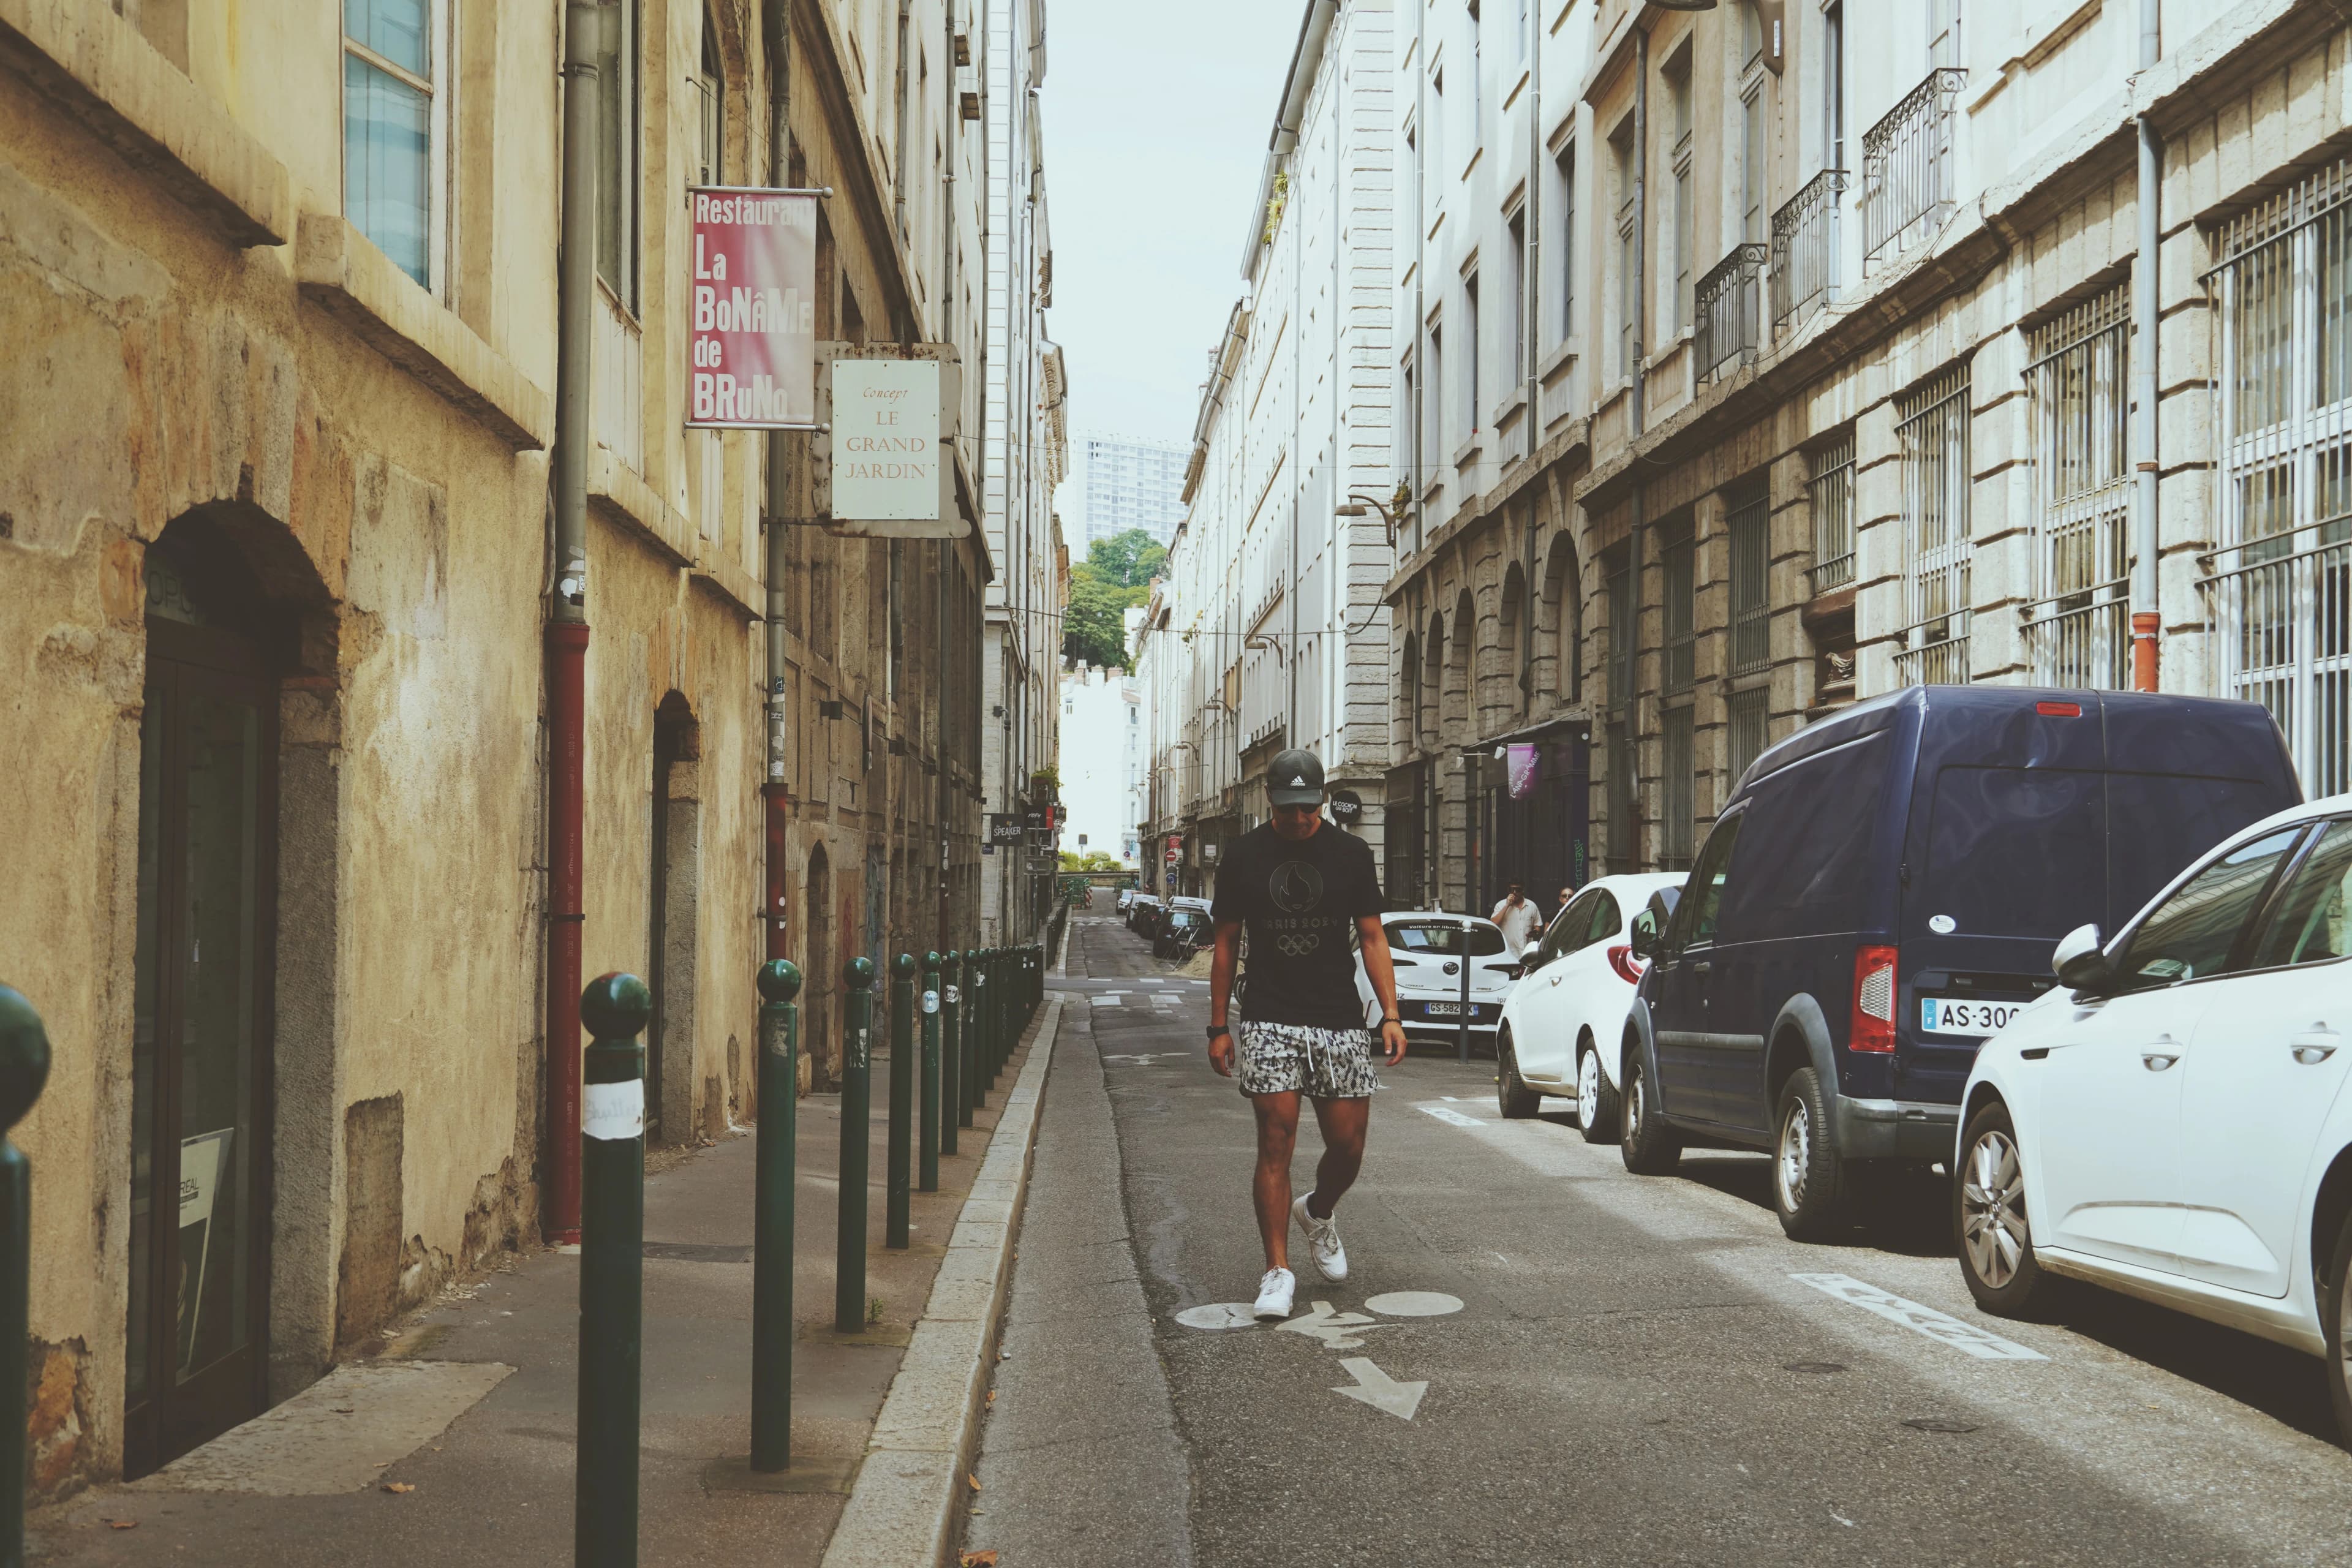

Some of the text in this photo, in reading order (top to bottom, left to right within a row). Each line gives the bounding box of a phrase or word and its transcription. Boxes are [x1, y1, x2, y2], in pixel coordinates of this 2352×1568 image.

[696, 233, 726, 281] La
[694, 334, 722, 368] de
[863, 387, 908, 405] Concept
[875, 411, 899, 426] LE
[846, 437, 926, 453] GRAND
[845, 463, 927, 480] JARDIN
[993, 826, 1021, 837] SPEAKER
[1430, 1003, 1473, 1013] GS-582-X
